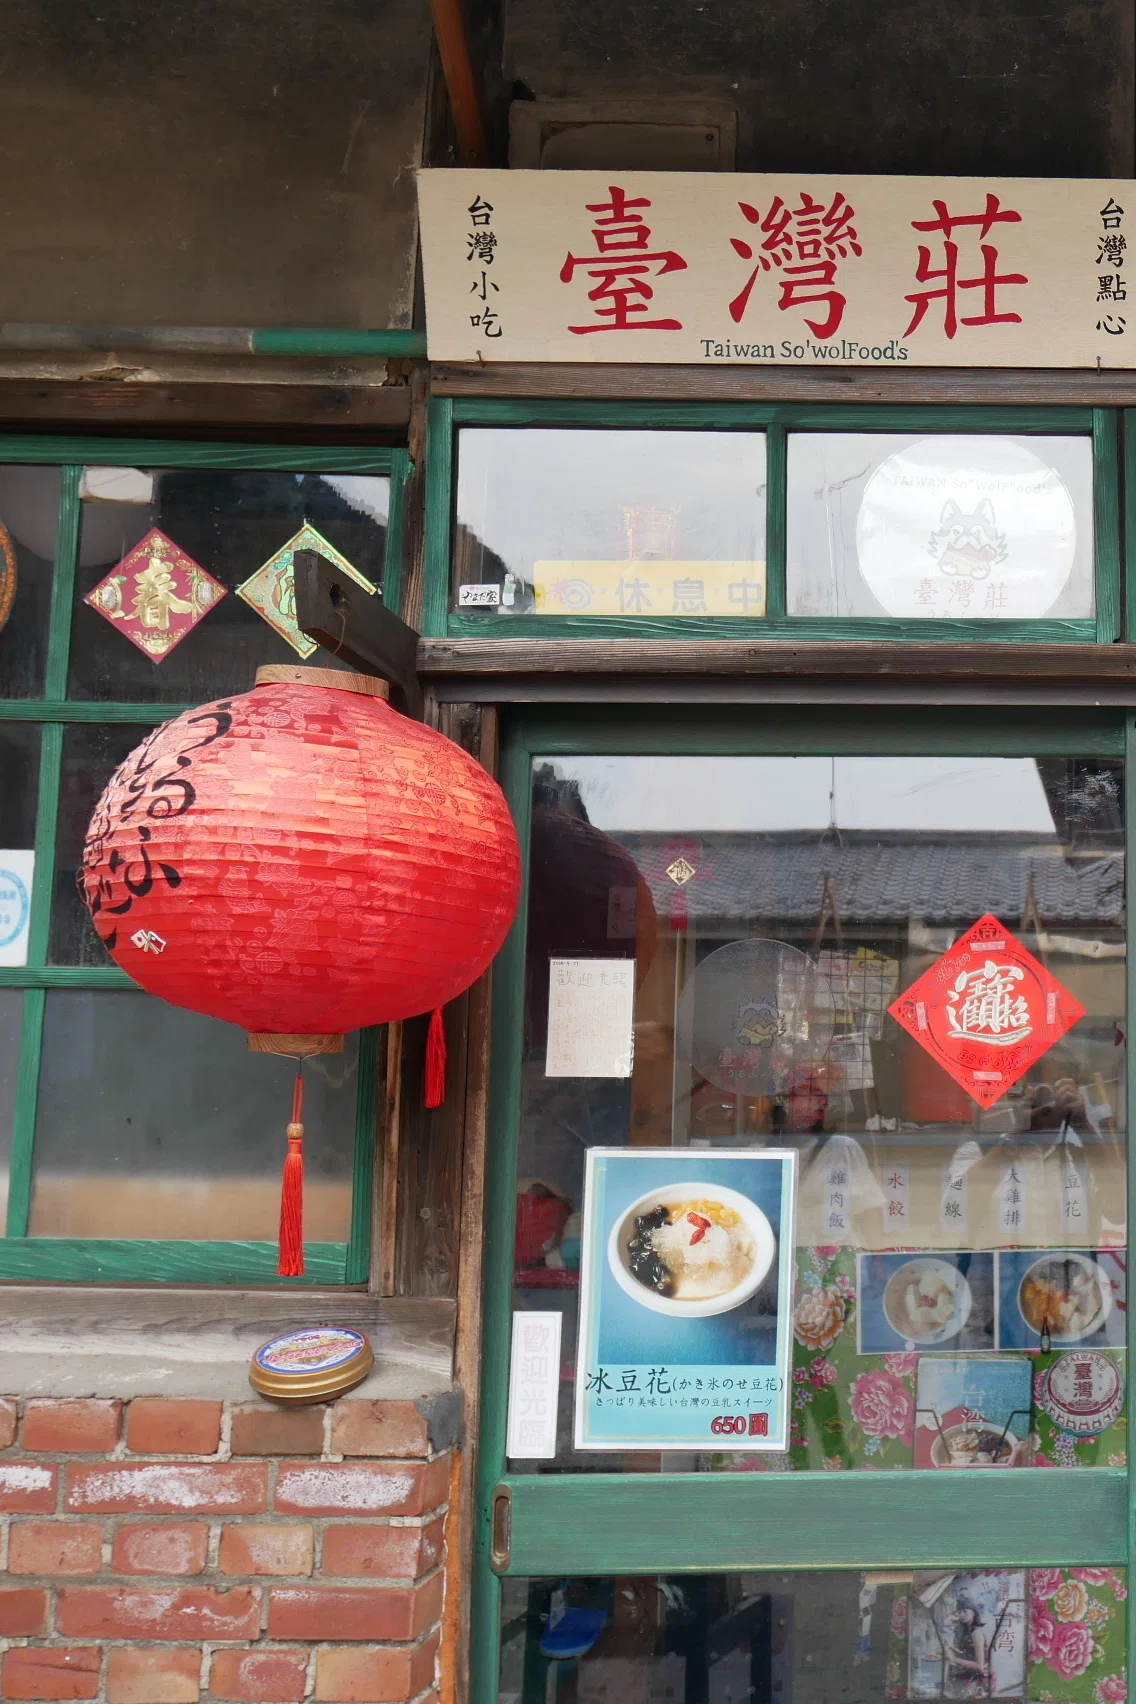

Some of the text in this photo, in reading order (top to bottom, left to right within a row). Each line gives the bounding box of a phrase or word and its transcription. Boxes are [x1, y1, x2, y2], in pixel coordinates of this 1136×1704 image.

[466, 195, 503, 338] 台灣小吃
[559, 186, 1029, 340] 臺灣莊
[1096, 199, 1128, 337] 台灣點心
[700, 339, 776, 359] Taiwan
[124, 557, 193, 631] 春
[616, 577, 762, 613] 休息中
[913, 577, 1010, 610] 臺灣莊
[887, 1173, 905, 1216] 水餃
[1064, 1175, 1082, 1218] 豆花
[1072, 1362, 1094, 1399] 臺灣
